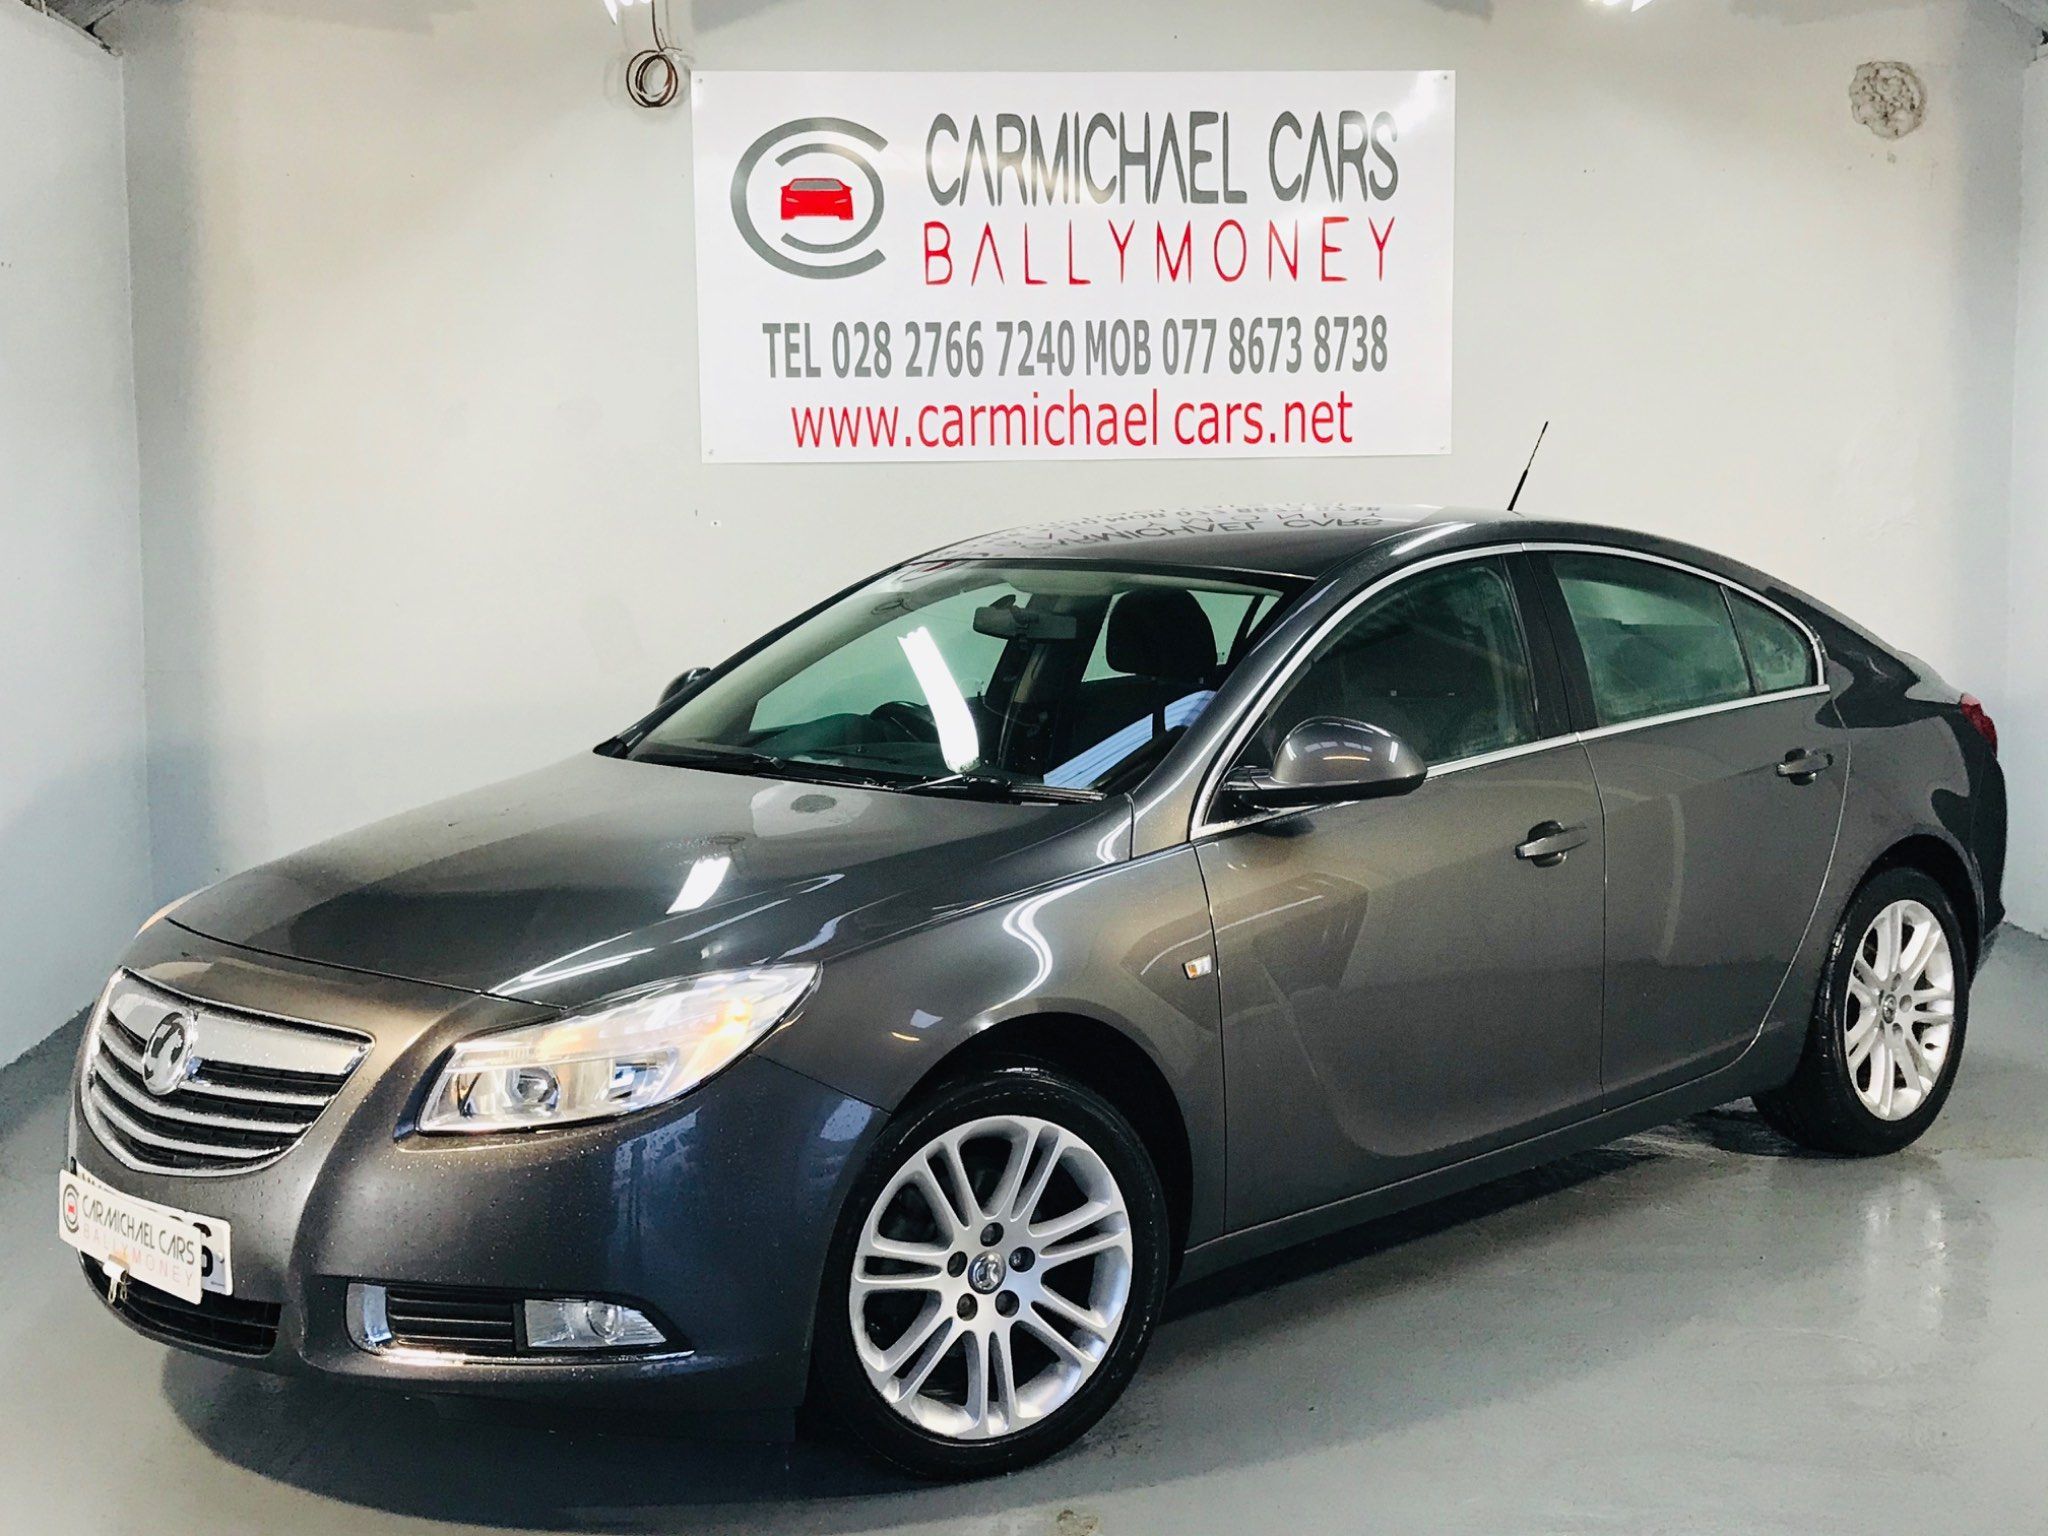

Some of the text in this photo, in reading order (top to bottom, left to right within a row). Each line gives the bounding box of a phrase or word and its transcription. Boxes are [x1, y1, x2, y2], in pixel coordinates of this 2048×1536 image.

[926, 110, 1398, 206] CARMICHAEL CARS
[924, 217, 1394, 286] BALLYMONEY
[763, 315, 1387, 378] TEL 028 2766 7240 MOB 077 8673 8738
[791, 389, 1353, 448] www.carmichael cars.net
[82, 1194, 155, 1250] CARMICHAEL
[159, 1230, 195, 1265] CARS
